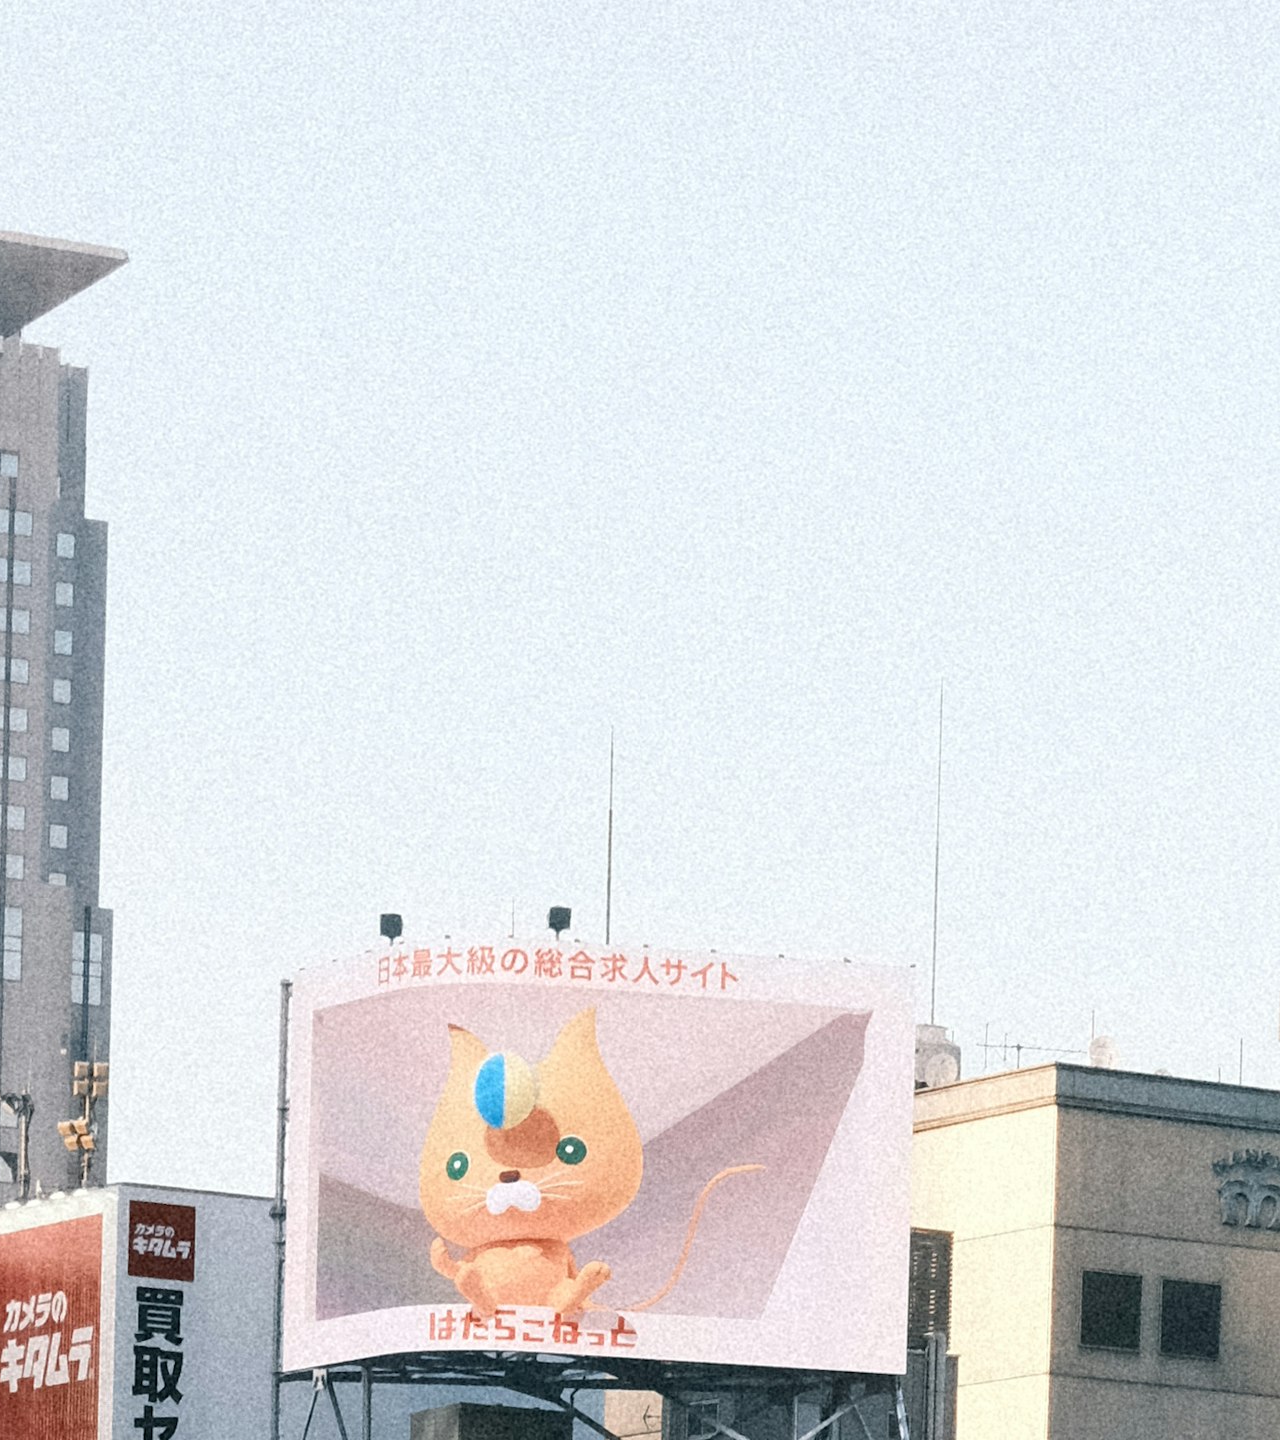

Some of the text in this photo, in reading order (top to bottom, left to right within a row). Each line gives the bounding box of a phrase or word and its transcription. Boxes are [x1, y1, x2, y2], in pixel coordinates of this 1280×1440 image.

[377, 945, 739, 991] 日本最大級の総合求人サイト
[132, 1237, 192, 1260] キタムラ
[135, 1222, 176, 1241] カメラの
[3, 1290, 68, 1334] カメラの
[428, 1310, 638, 1349] はたらこねっと
[0, 1325, 94, 1394] キタムラ
